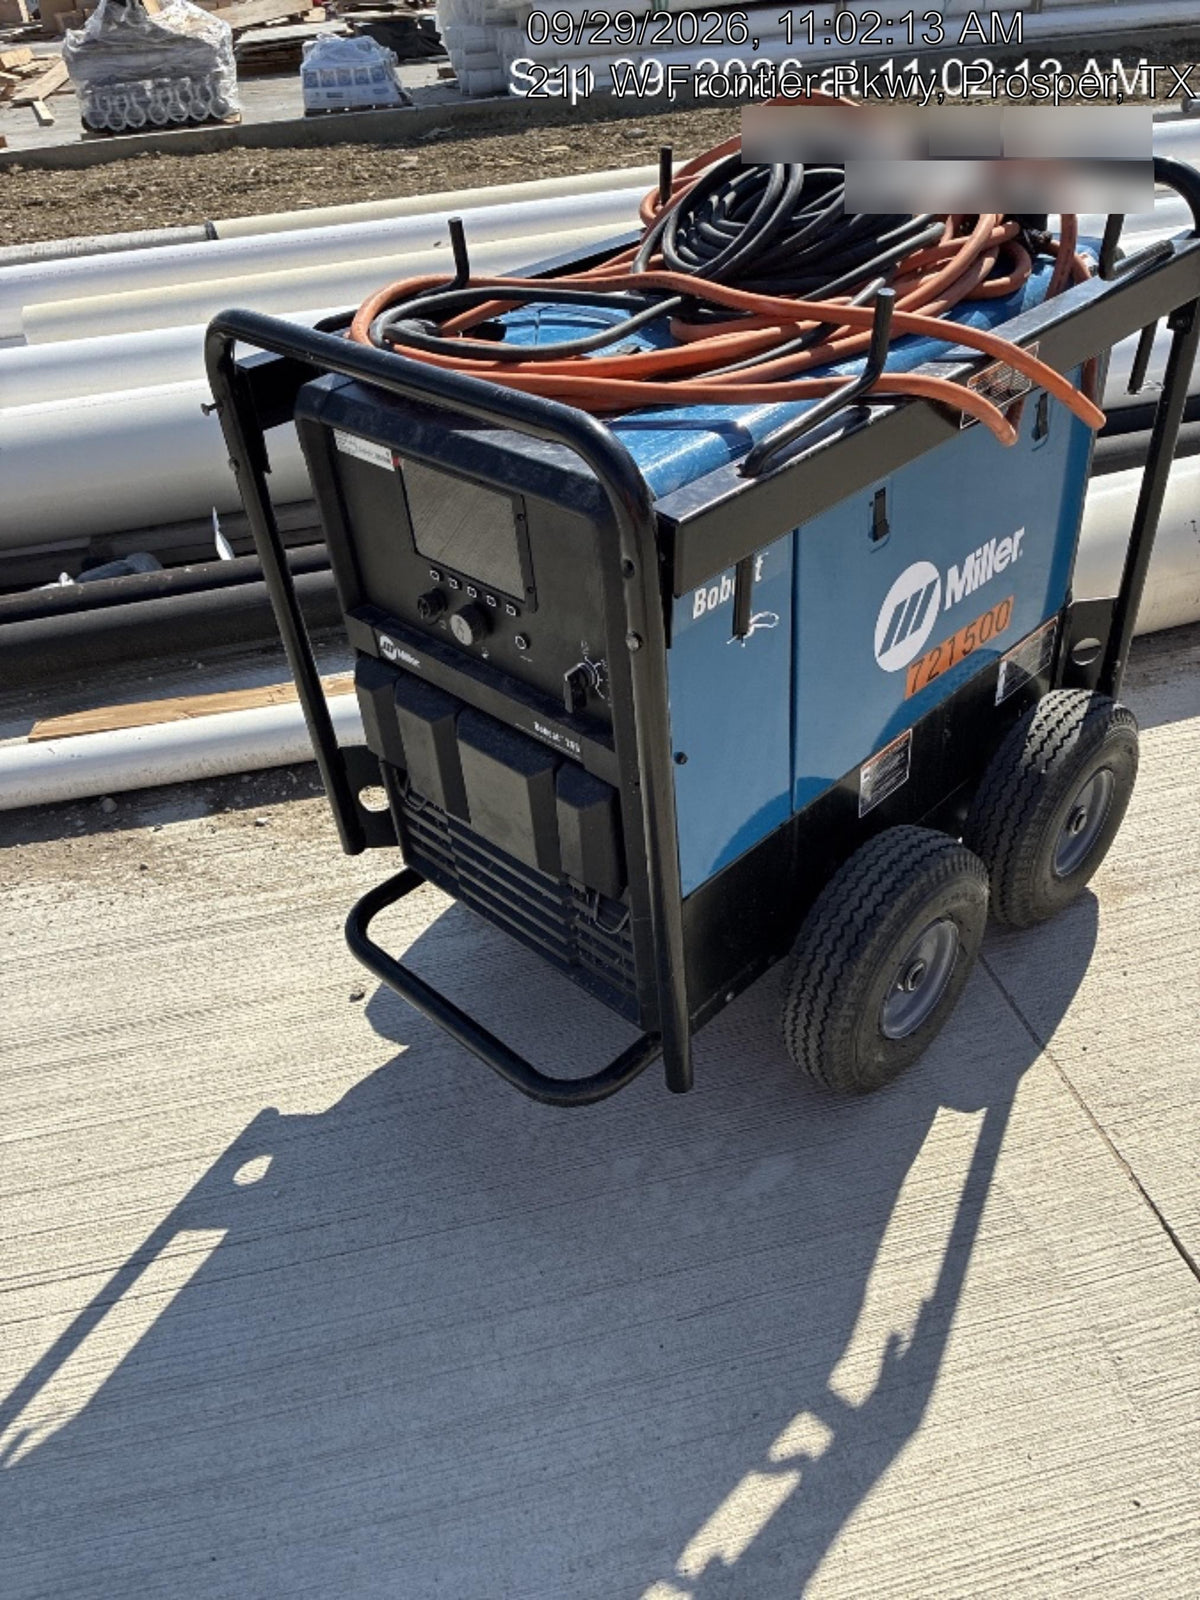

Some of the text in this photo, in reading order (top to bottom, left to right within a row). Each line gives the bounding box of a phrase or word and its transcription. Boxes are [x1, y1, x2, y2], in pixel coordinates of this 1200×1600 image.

[692, 552, 766, 619] Bobt
[944, 526, 1025, 612] Miller
[911, 599, 1012, 695] 721500
